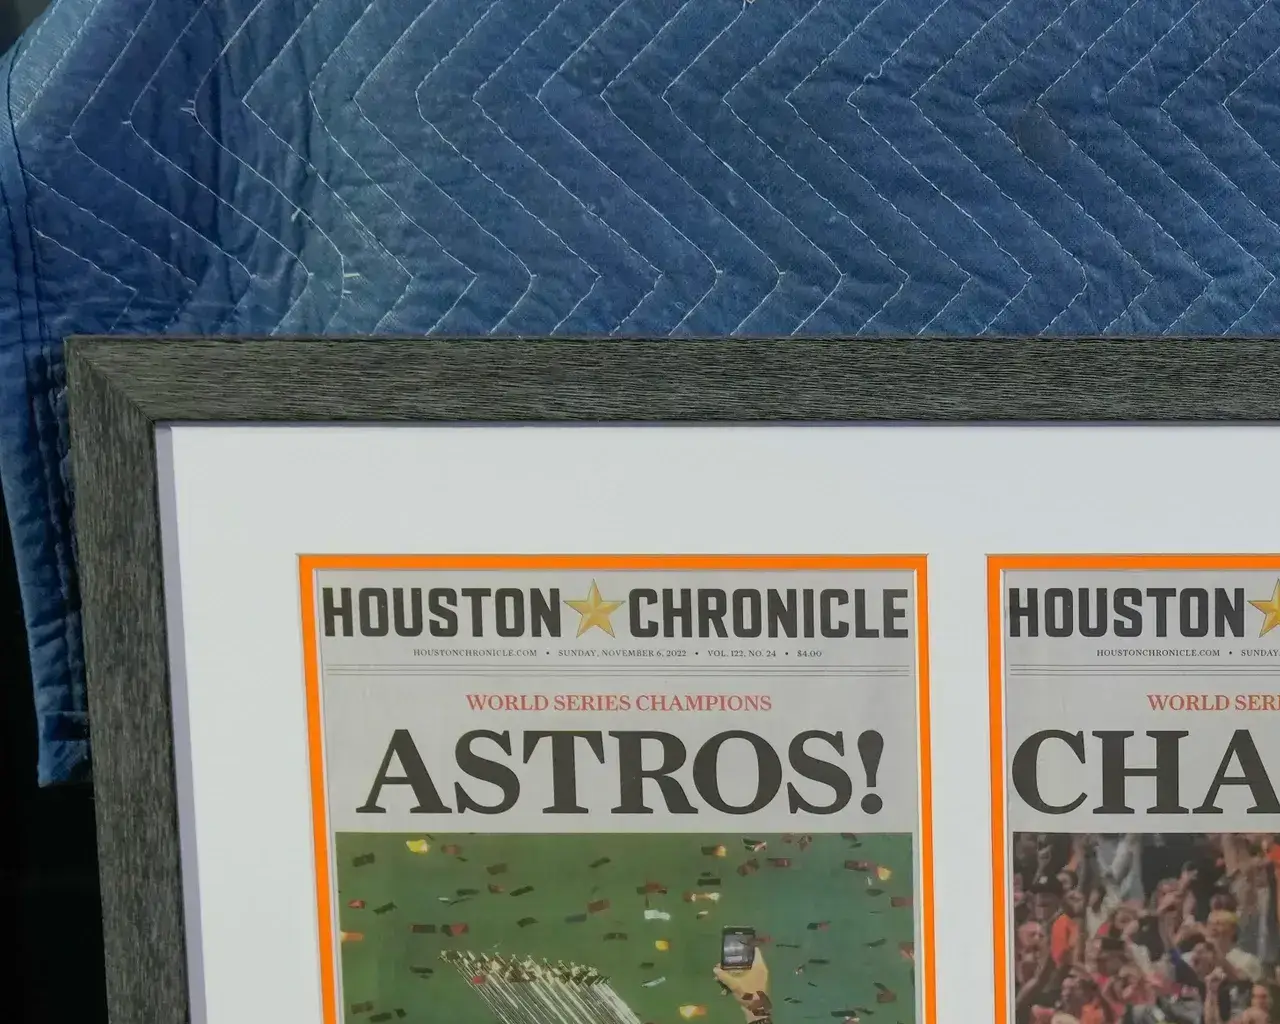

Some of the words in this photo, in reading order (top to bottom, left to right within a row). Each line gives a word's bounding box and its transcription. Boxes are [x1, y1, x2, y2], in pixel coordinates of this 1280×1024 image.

[322, 587, 562, 638] HOUSTON
[628, 588, 909, 638] CHRONICLE
[1008, 587, 1245, 638] HOUSTON
[413, 648, 537, 657] HOUSTONCHRONICLE.COM
[601, 649, 654, 657] NOVEMBER
[666, 649, 687, 657] 2022
[766, 650, 777, 658] 24
[796, 649, 823, 658] $4.00
[1096, 649, 1220, 657] HOUSTONCHRONICLE.COM
[466, 694, 549, 711] WORLD
[554, 694, 631, 712] SERIES
[636, 694, 772, 712] CHAMPIONS
[1146, 694, 1230, 711] WORLD
[355, 728, 884, 815] ASTROS!
